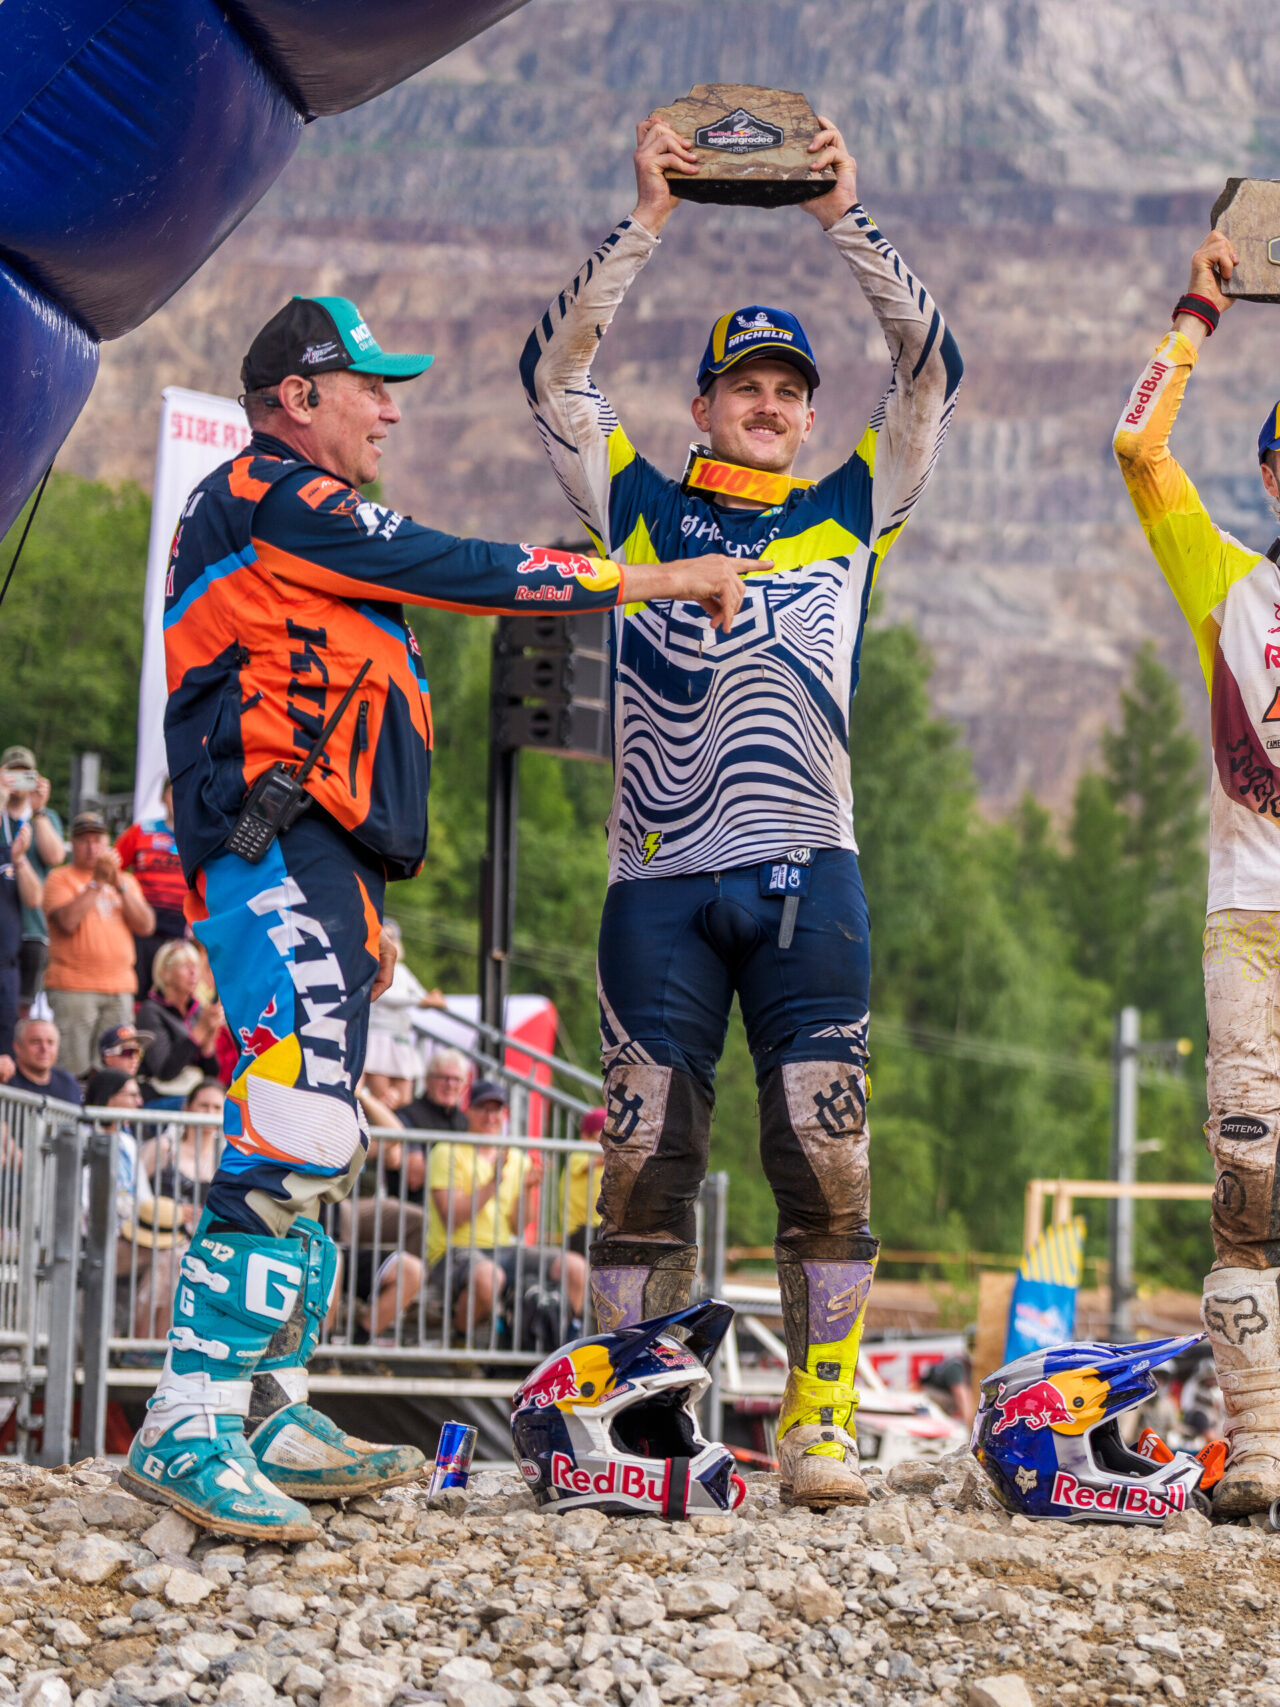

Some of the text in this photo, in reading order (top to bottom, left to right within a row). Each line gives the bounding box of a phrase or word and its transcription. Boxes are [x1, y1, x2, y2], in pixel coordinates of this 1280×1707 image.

[733, 116, 748, 132] 2
[708, 136, 774, 145] erzbergrodeo
[728, 330, 793, 348] MICHELIN
[1125, 361, 1168, 424] Red Bull
[694, 461, 781, 501] 100%
[515, 585, 574, 600] Red Bull
[1220, 1123, 1264, 1135] ORTEMA
[245, 1252, 303, 1322] G
[521, 1464, 538, 1478] BELL
[552, 1452, 690, 1504] Red Bu
[1052, 1472, 1186, 1517] Red Bull
